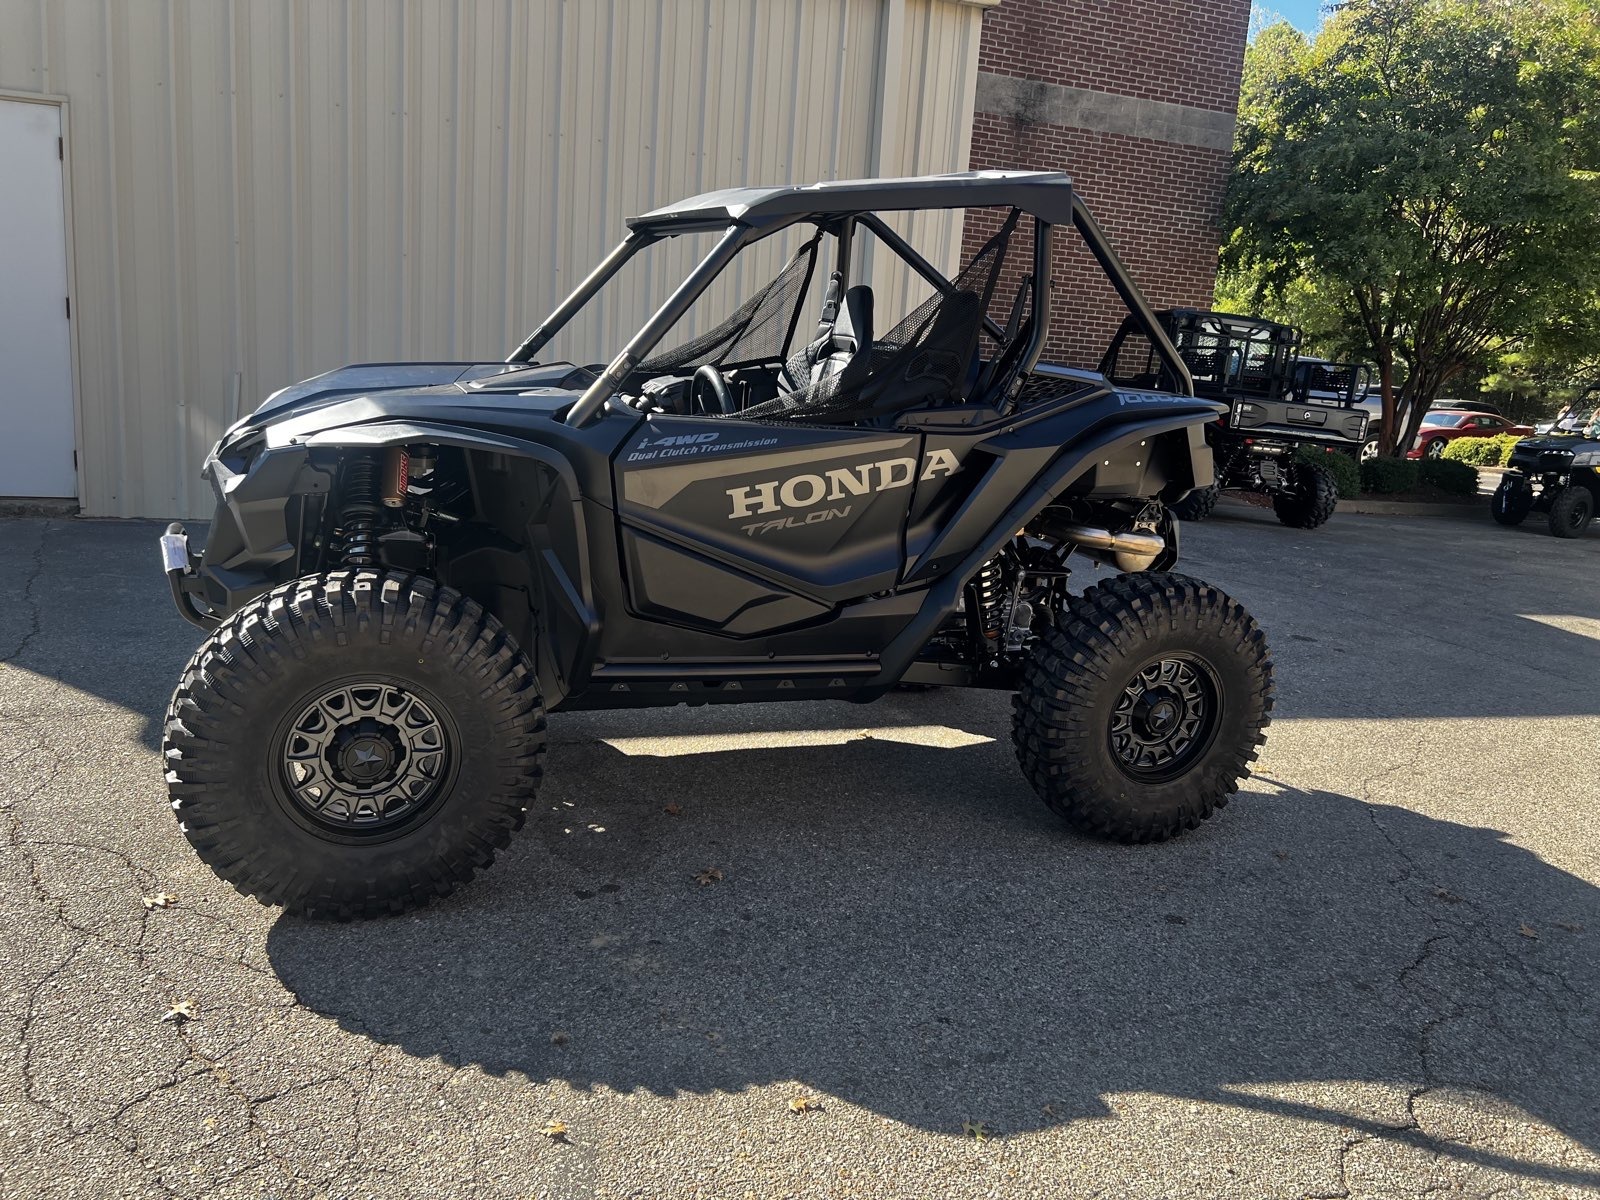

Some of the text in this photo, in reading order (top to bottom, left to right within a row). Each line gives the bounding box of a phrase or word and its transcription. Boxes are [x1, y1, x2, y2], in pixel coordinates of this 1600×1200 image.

[627, 437, 778, 462] Dual Clutch Transmission
[637, 432, 720, 450] i-4WD
[726, 448, 961, 520] HONDA
[740, 505, 851, 537] TALON
